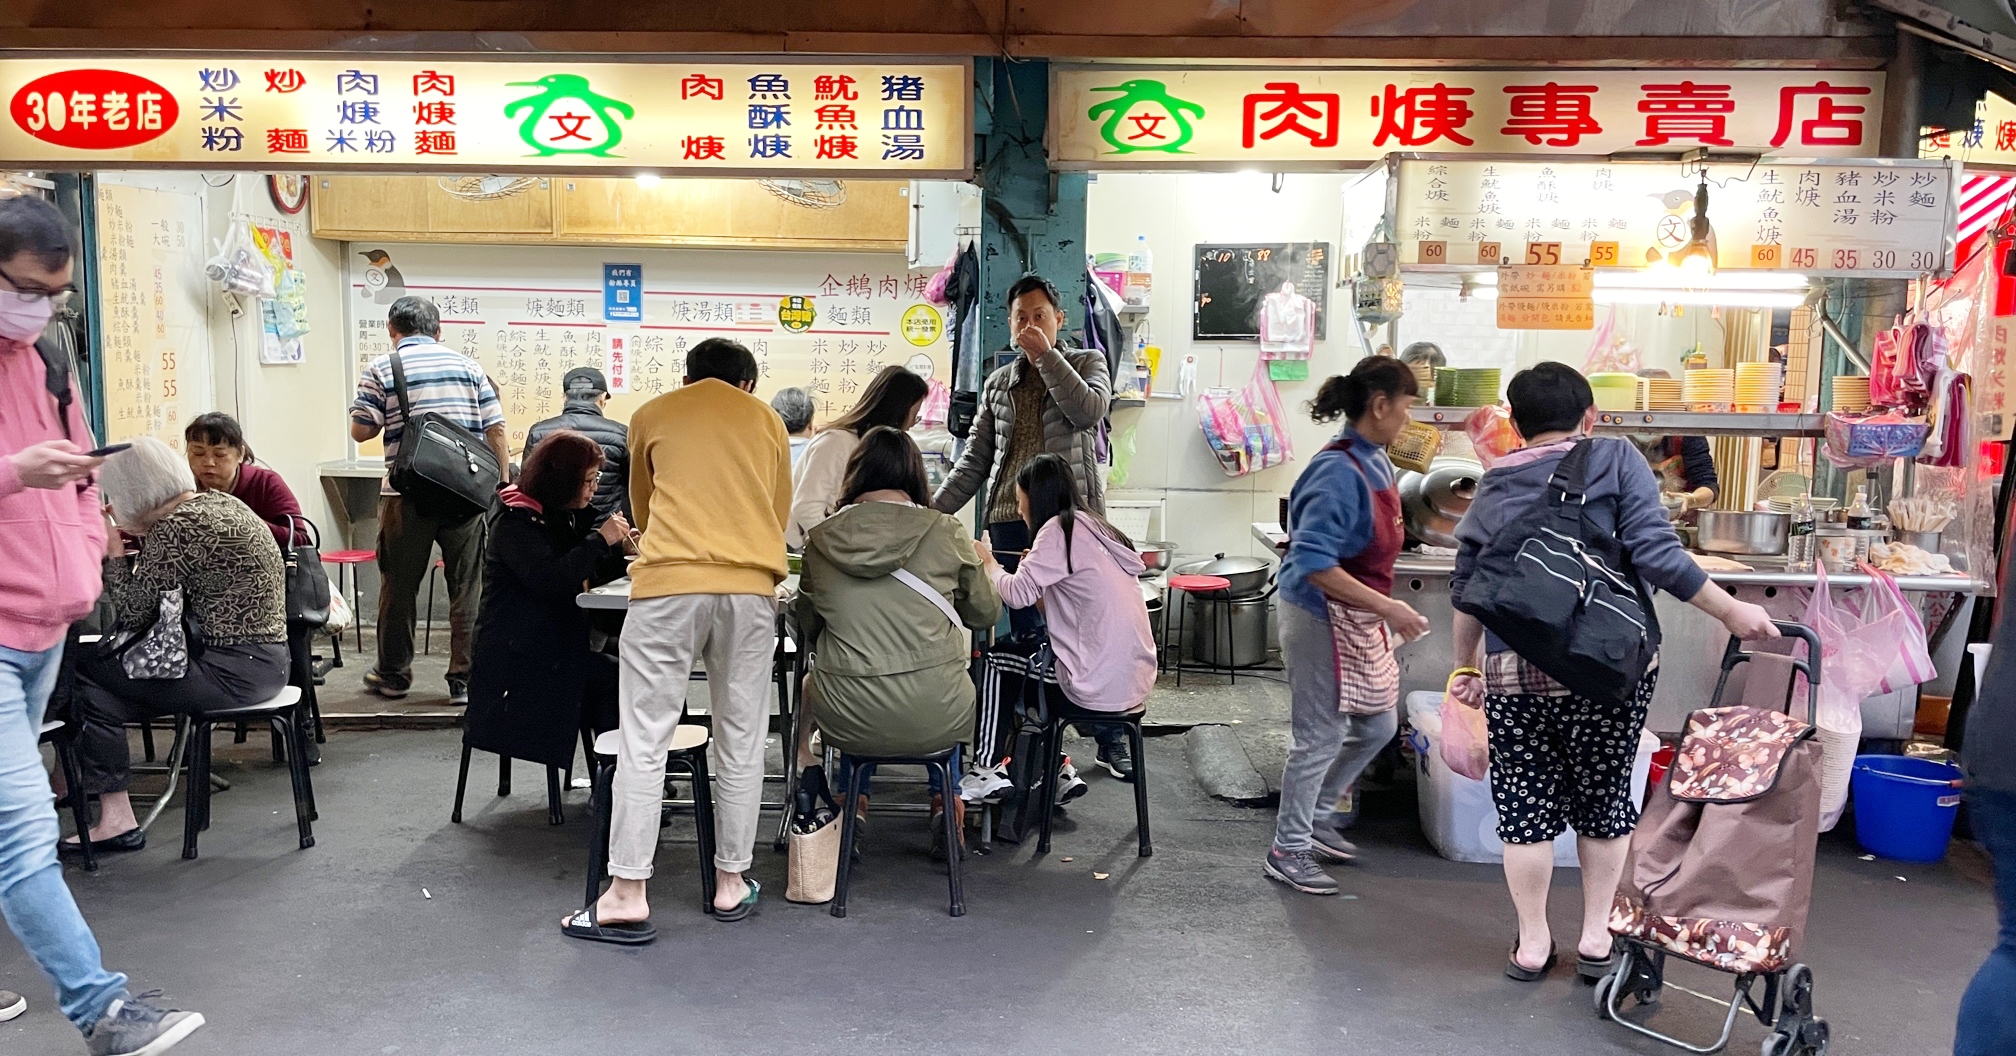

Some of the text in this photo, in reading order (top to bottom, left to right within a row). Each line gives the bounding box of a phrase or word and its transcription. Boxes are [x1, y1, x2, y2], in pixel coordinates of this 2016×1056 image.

[26, 90, 163, 132] 30年老店
[199, 67, 244, 153] 炒米粉
[265, 68, 311, 154] 炒麵
[548, 111, 592, 142] 文
[1127, 112, 1167, 140] 文
[1833, 170, 1862, 226] 豬血湯
[1869, 171, 1900, 226] 炒米粉
[1908, 172, 1938, 208] 炒麵
[1412, 216, 1433, 241] 米粉
[1440, 216, 1460, 229] 麵
[1467, 217, 1488, 242] 米粉
[1495, 217, 1515, 230] 麵
[1523, 217, 1544, 242] 米粉
[1579, 217, 1600, 242] 米粉
[1659, 218, 1684, 243] 文
[1426, 245, 1442, 258] 60
[1480, 246, 1497, 259] 60
[1528, 243, 1560, 266] 55
[1595, 246, 1613, 261] 55
[1757, 248, 1775, 262] 60
[1791, 248, 1815, 268] 45
[1834, 249, 1857, 269] 35
[1872, 250, 1896, 269] 30
[1910, 251, 1934, 270] 30
[359, 319, 388, 330] 營業時
[827, 304, 871, 326] 麵類
[162, 352, 176, 370] 55
[612, 338, 623, 388] 請先付款
[837, 339, 860, 394] 炒米粉
[163, 379, 177, 398] 55
[168, 410, 177, 422] 60
[512, 431, 524, 441] 60
